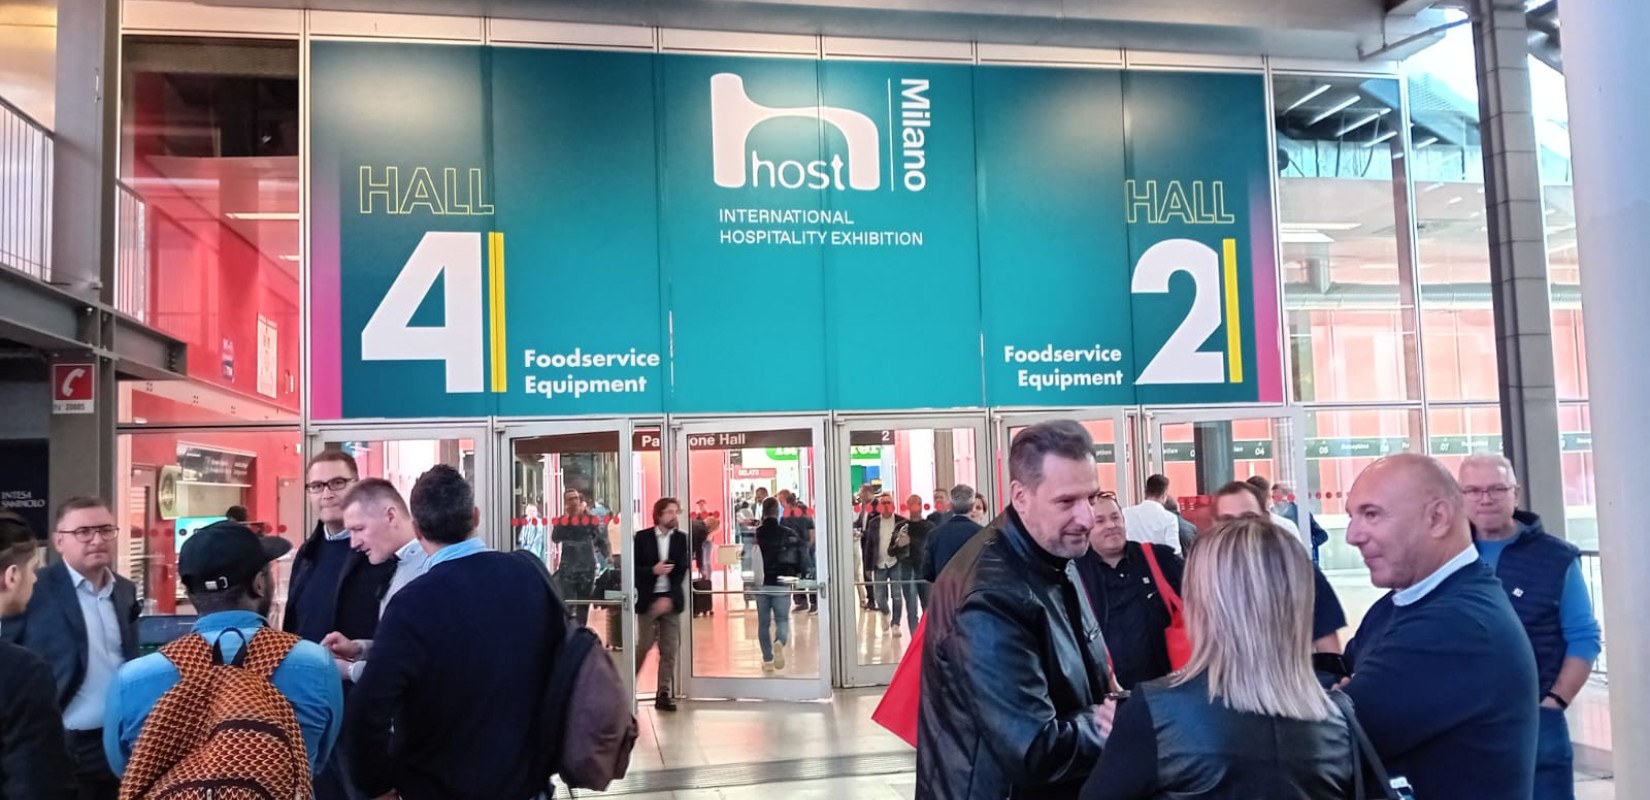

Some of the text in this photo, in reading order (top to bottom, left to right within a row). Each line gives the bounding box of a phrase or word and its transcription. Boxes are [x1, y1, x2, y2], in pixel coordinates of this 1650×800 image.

[900, 78, 931, 192] Milano
[752, 150, 846, 191] host
[360, 166, 494, 215] HALL
[1125, 179, 1235, 224] HALL
[719, 208, 855, 225] INTERNATIONAL
[720, 229, 924, 246] HOSPITALITY EXHIBITION
[361, 231, 485, 394] 4
[1131, 238, 1225, 385] 2
[524, 347, 660, 368] Foodservice
[1004, 344, 1122, 362] Foodservice
[525, 374, 647, 399] Equipment
[1018, 369, 1123, 391] Equipment
[720, 433, 746, 445] Hall
[882, 430, 890, 441] 2
